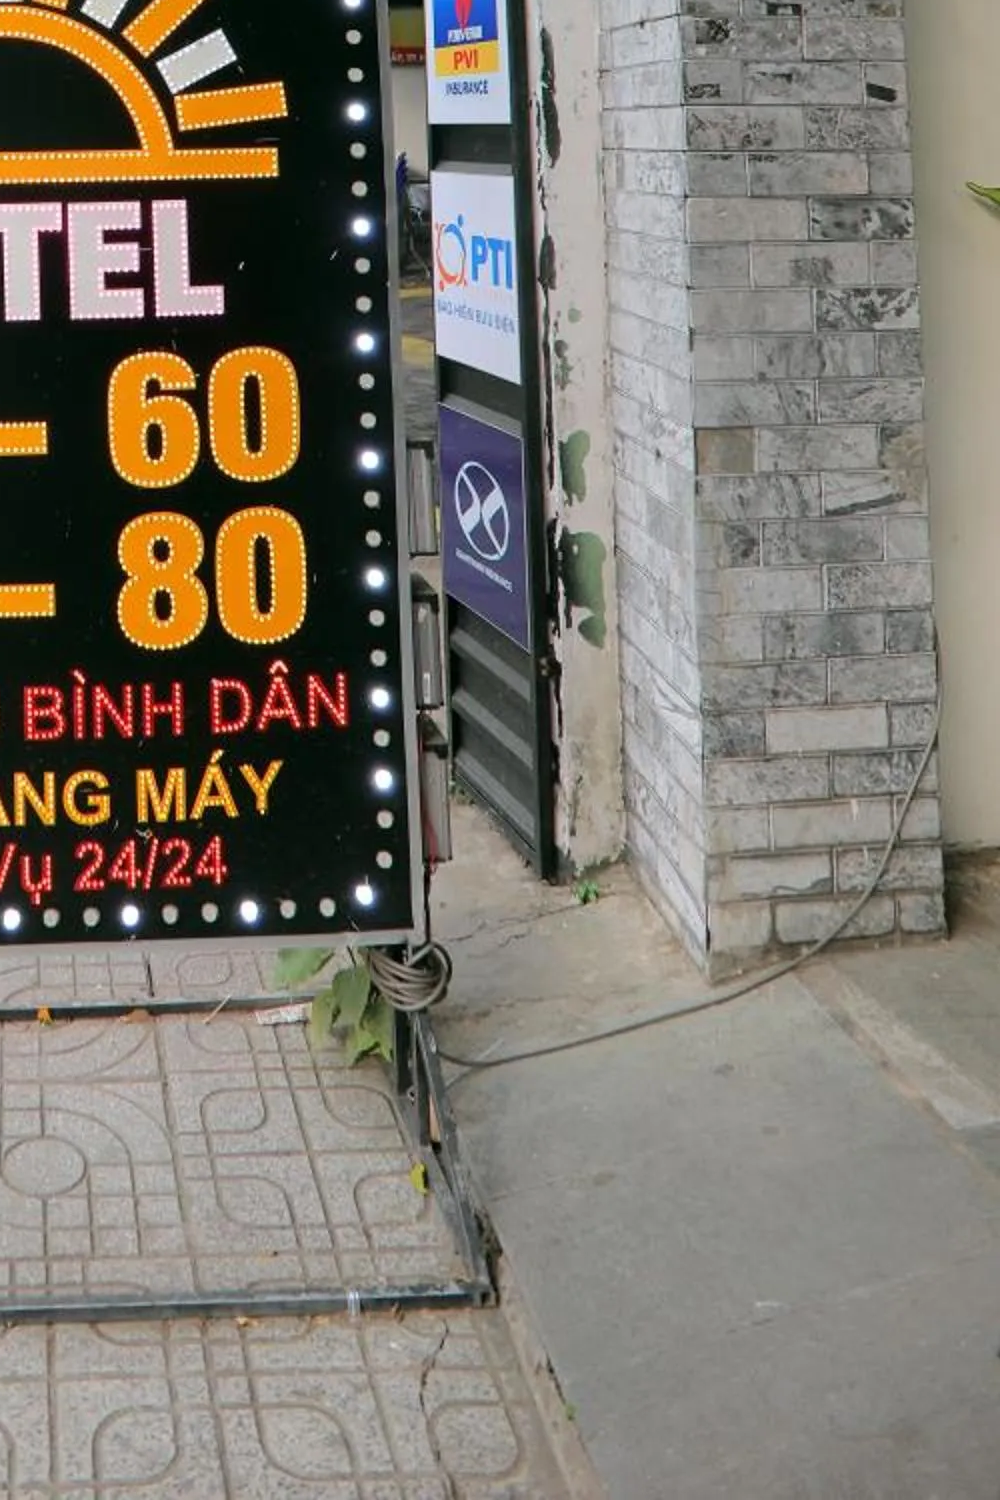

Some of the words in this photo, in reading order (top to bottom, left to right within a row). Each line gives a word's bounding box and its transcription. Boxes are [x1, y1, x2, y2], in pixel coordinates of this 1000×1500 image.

[453, 48, 479, 70] PVI
[471, 235, 513, 290] PTI
[105, 345, 302, 489] 60
[116, 505, 308, 651] 80
[23, 668, 186, 741] BÌNH
[209, 659, 350, 734] DÂN
[135, 748, 285, 822] MÁY
[73, 834, 228, 892] 24/24
